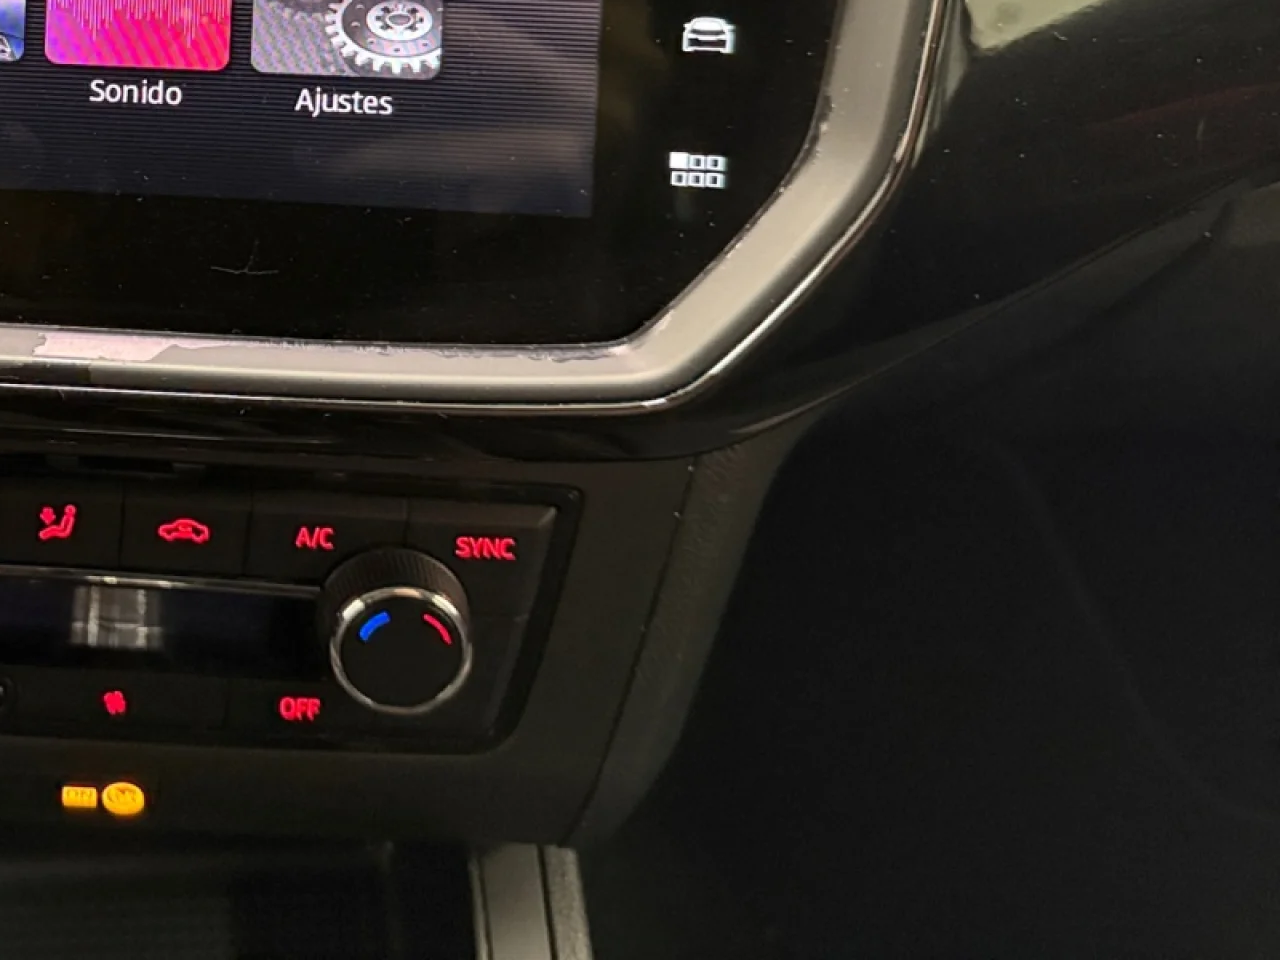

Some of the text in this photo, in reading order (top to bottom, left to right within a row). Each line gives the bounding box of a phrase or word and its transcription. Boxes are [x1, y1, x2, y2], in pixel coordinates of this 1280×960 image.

[89, 79, 182, 105] Sonido
[294, 87, 393, 117] Ajustes
[295, 526, 334, 550] A/C
[455, 536, 516, 561] SYNC
[279, 696, 321, 721] OFF
